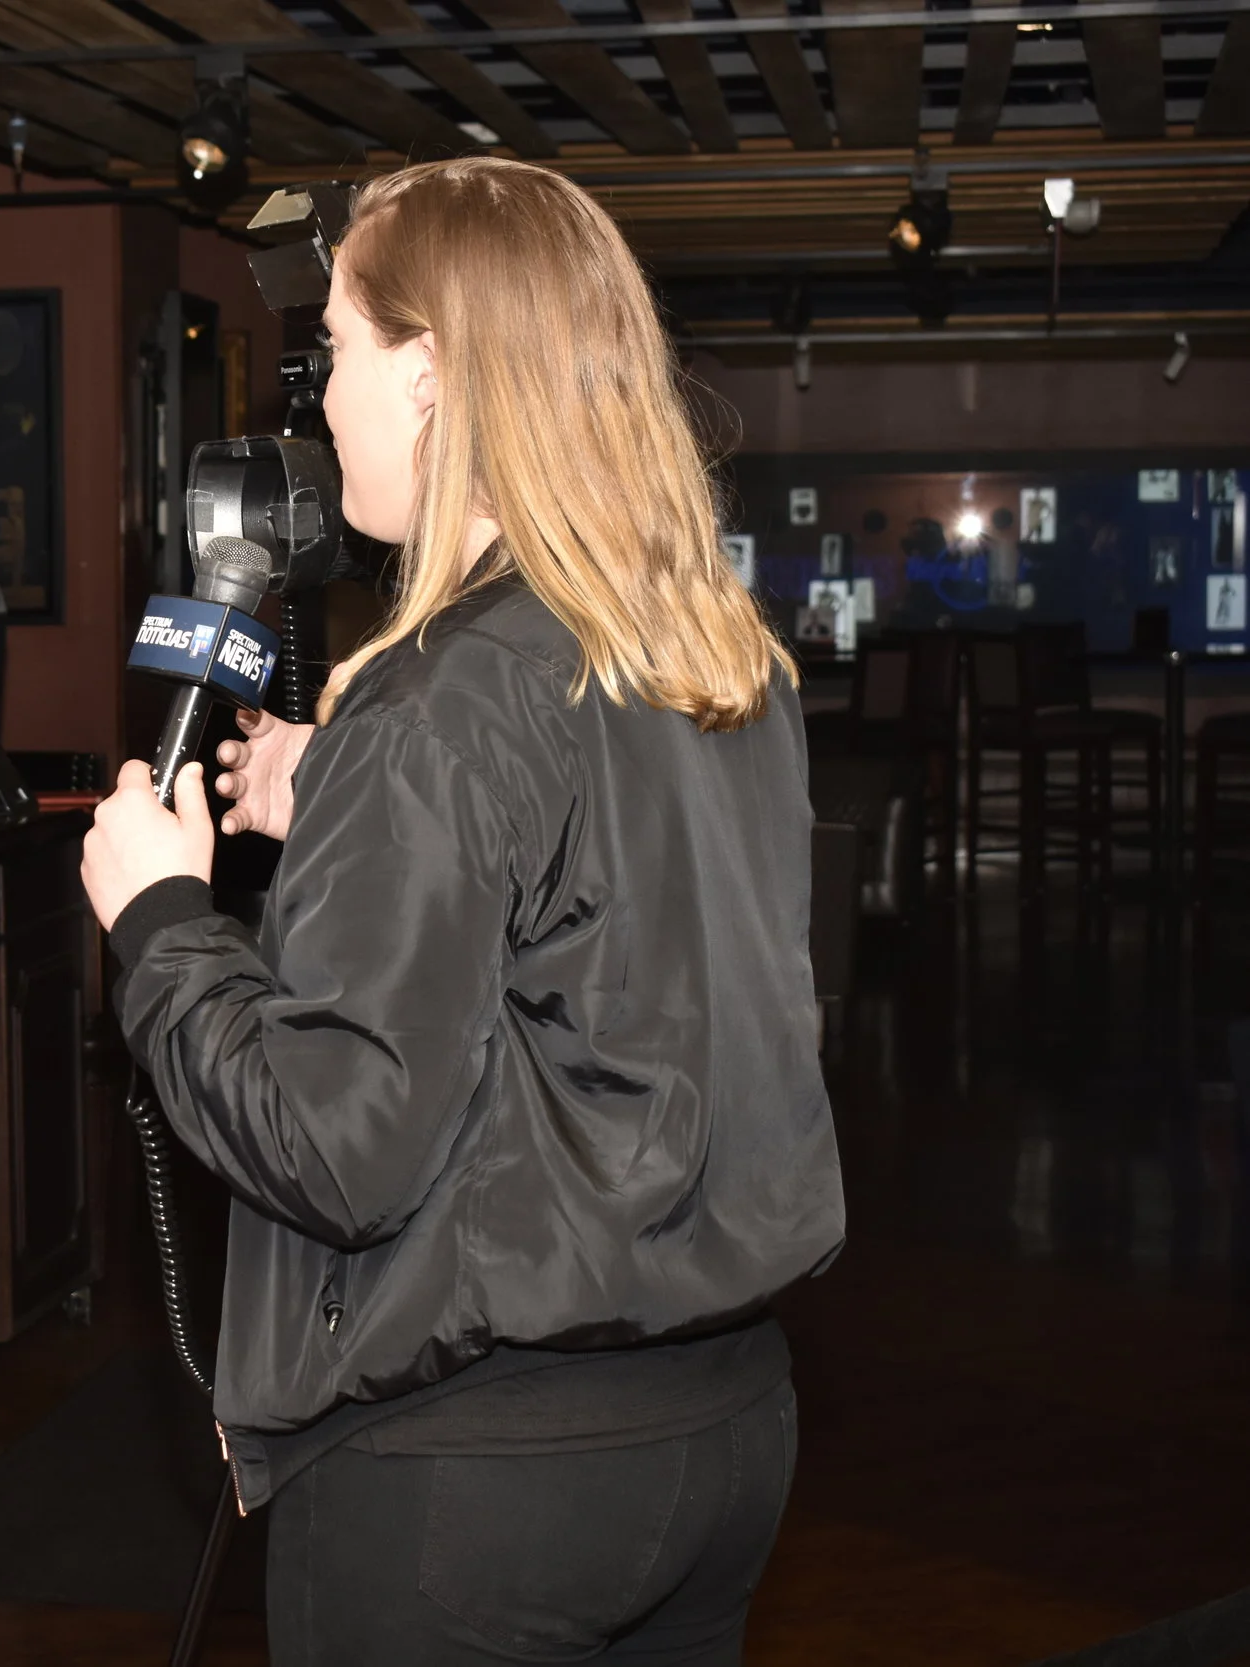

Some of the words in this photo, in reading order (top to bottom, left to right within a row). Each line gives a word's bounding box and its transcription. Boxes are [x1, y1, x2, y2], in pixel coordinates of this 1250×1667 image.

[280, 365, 303, 374] Panasonic
[142, 615, 173, 628] SPECTRUM
[227, 628, 262, 654] SPECTRUM
[217, 638, 264, 682] NEWS
